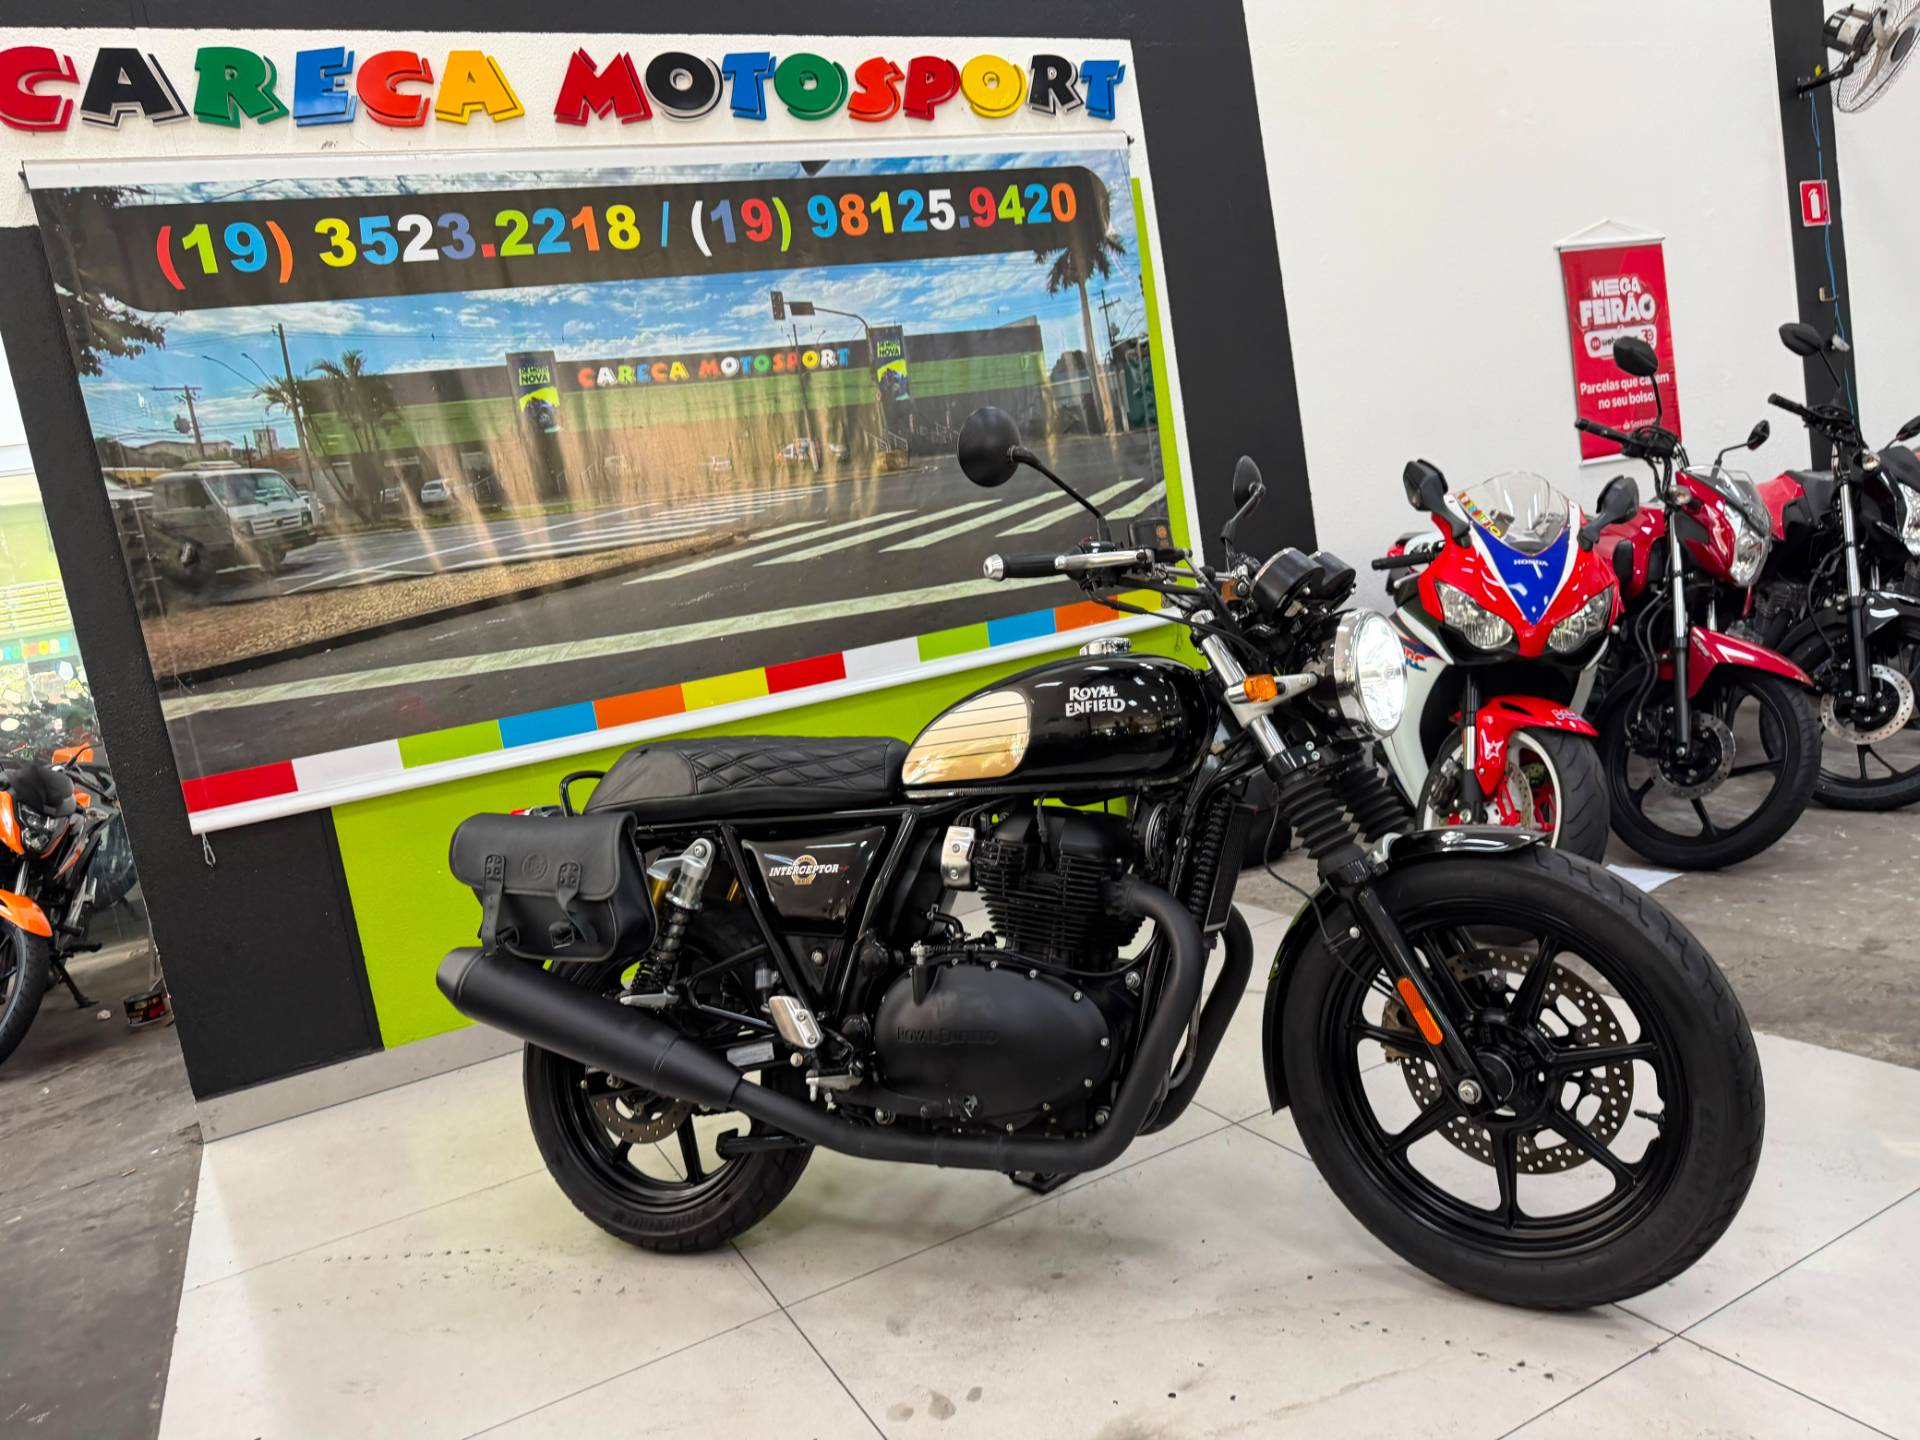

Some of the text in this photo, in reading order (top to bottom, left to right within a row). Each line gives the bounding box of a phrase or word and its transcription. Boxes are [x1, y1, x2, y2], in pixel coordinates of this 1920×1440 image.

[0, 46, 1125, 132] CARECA MOTOSPORT
[157, 221, 293, 290] (19)
[315, 205, 641, 268] 3523.2218
[691, 196, 791, 257] (19)
[807, 183, 1077, 238] 98125.9420
[1592, 278, 1641, 297] MEGA
[1579, 292, 1656, 327] FEIRÃO
[578, 348, 849, 388] CARECA MOTOSPORT
[521, 374, 549, 384] NOVA
[1580, 373, 1669, 396] Parcelas que caem
[1598, 398, 1611, 410] no
[1612, 395, 1628, 409] seu
[1513, 559, 1549, 567] HONDA
[1069, 685, 1118, 701] ROYAL
[1065, 698, 1126, 717] ENFIELD
[769, 863, 839, 877] INTERCEPTOR
